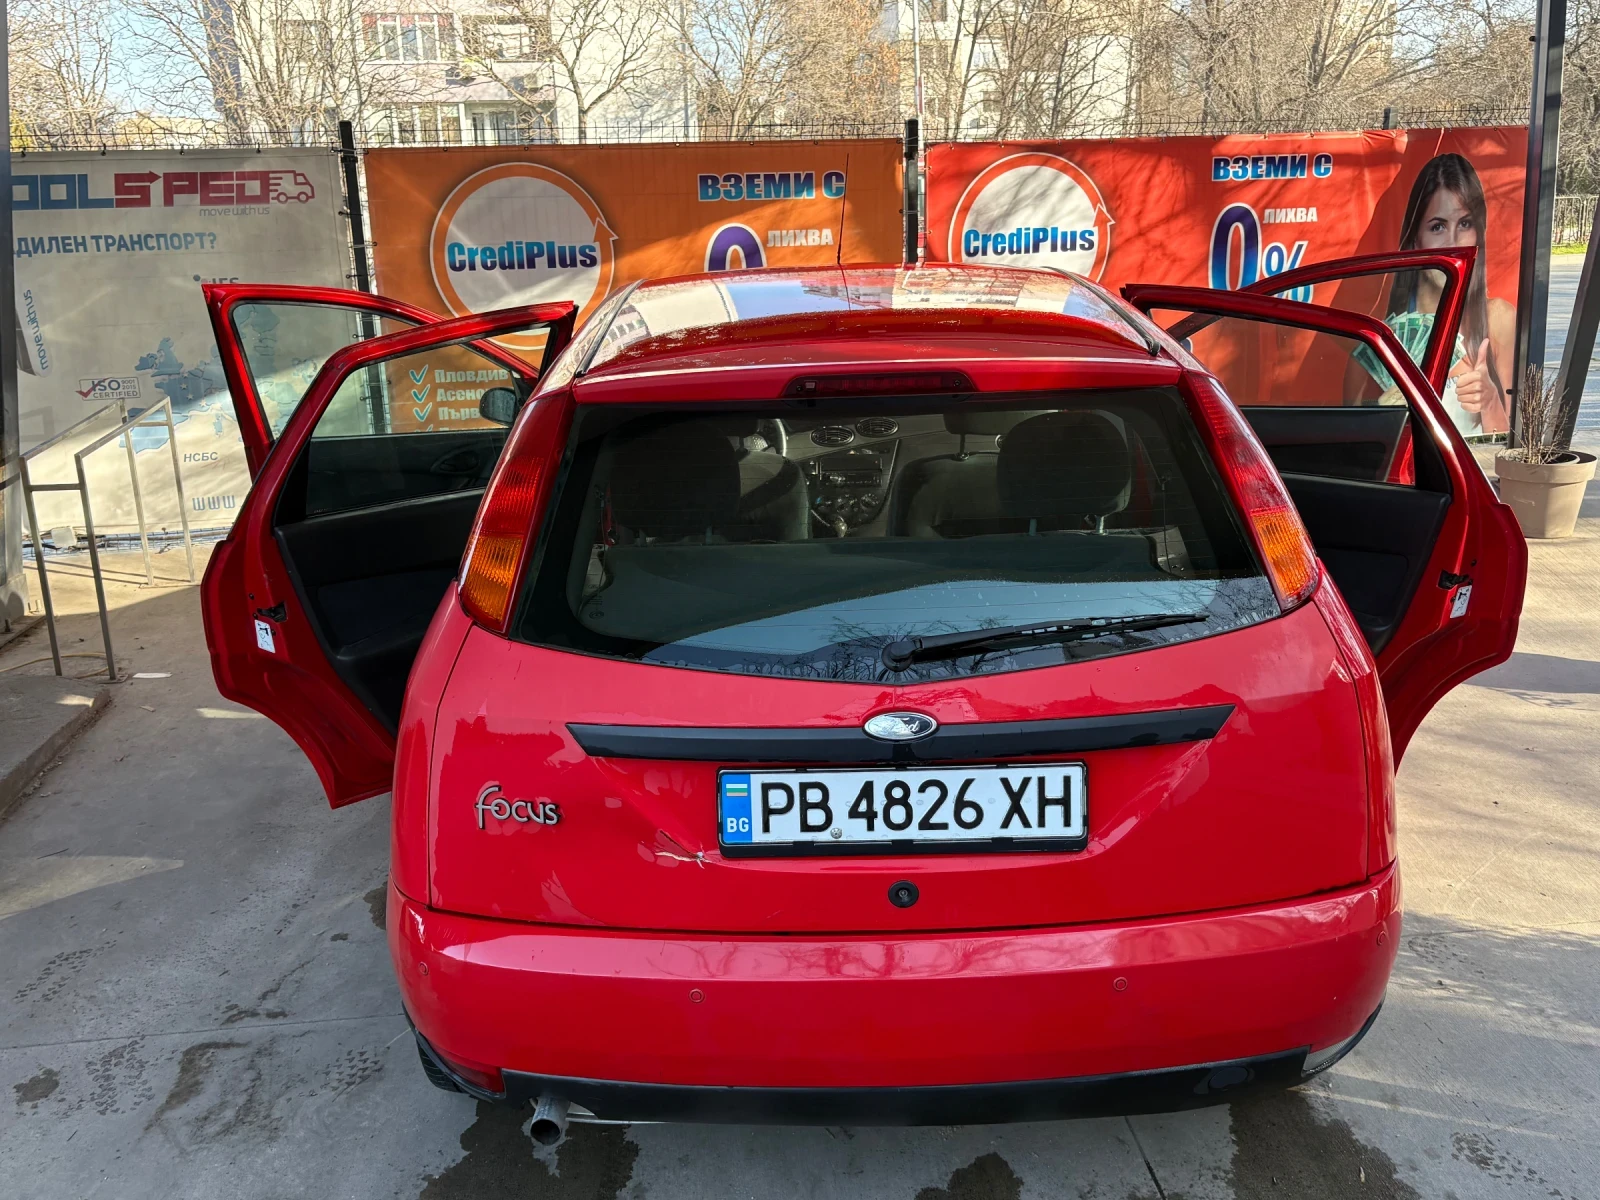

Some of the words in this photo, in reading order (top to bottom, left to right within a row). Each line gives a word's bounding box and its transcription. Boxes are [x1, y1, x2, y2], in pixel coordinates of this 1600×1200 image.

[1212, 153, 1308, 181] ВЗЕМИ
[1313, 152, 1333, 178] С
[698, 171, 815, 201] ВЗЕМИ
[822, 170, 845, 199] С
[1263, 207, 1318, 224] ЛИХВА
[14, 235, 87, 258] ДИЛЕН
[91, 232, 217, 253] ТРАНСПОРТ?
[767, 228, 834, 247] ЛИХВА
[964, 227, 1095, 257] CrediPlus
[447, 240, 598, 272] CrediPlus
[92, 379, 121, 391] ISO
[434, 369, 509, 383] Пловдив
[93, 390, 138, 398] CERTIFIED
[436, 388, 486, 402] Асено
[183, 452, 218, 462] НСБС
[761, 781, 834, 833] PB
[848, 777, 984, 831] 4826
[999, 775, 1072, 829] XH
[726, 817, 749, 833] BG
